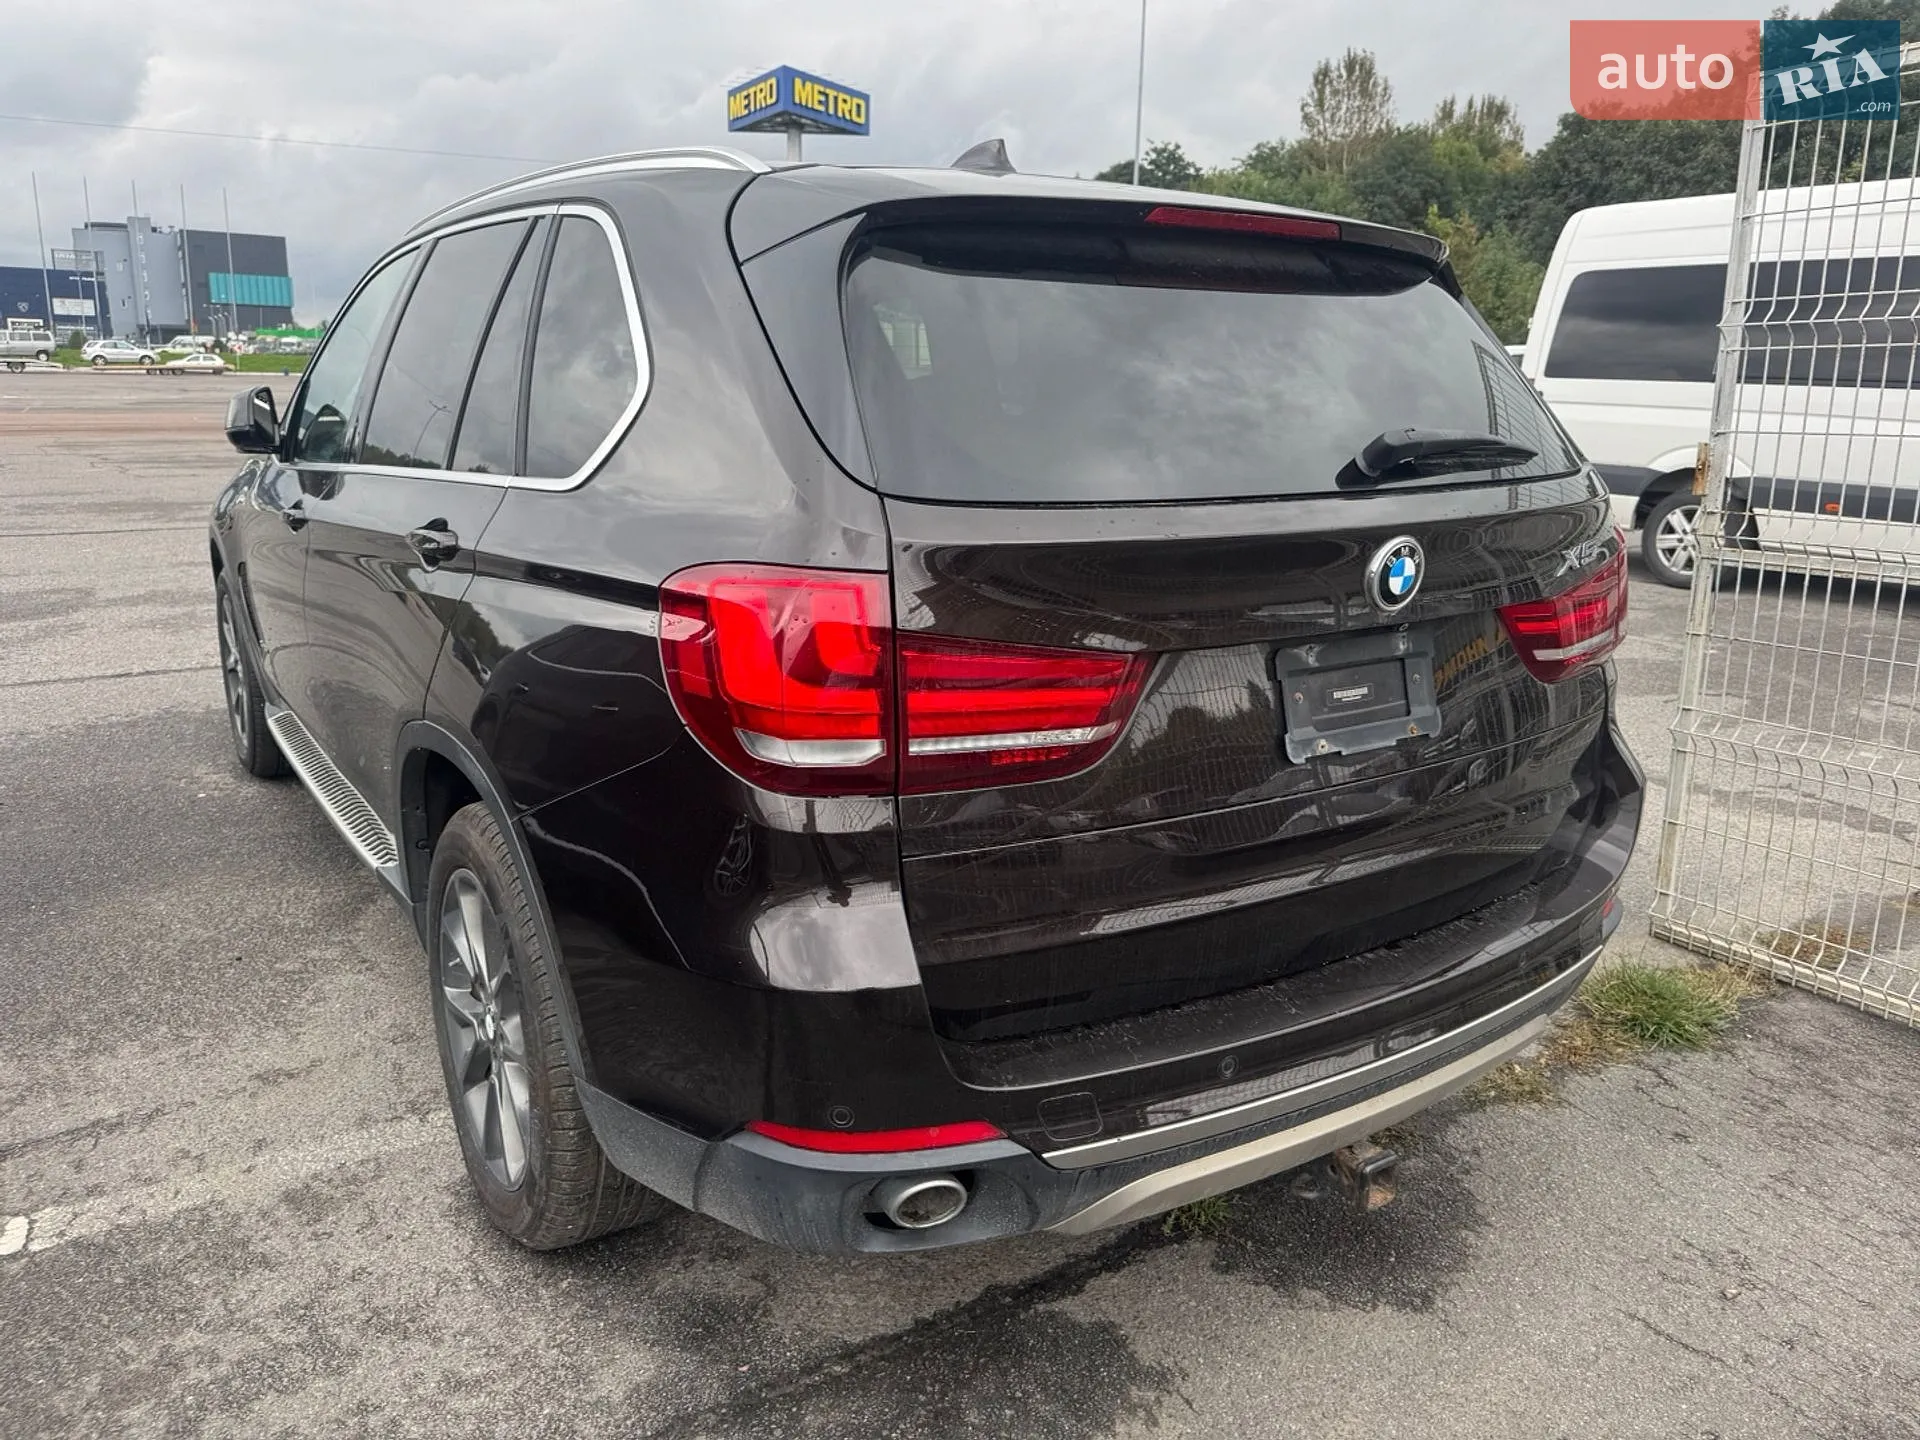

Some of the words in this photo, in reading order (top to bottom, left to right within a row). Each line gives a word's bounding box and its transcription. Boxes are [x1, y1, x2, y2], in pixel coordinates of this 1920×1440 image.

[729, 76, 777, 121] METRO
[794, 77, 866, 125] METRO
[1386, 546, 1421, 568] BMW
[1554, 539, 1609, 577] X5
